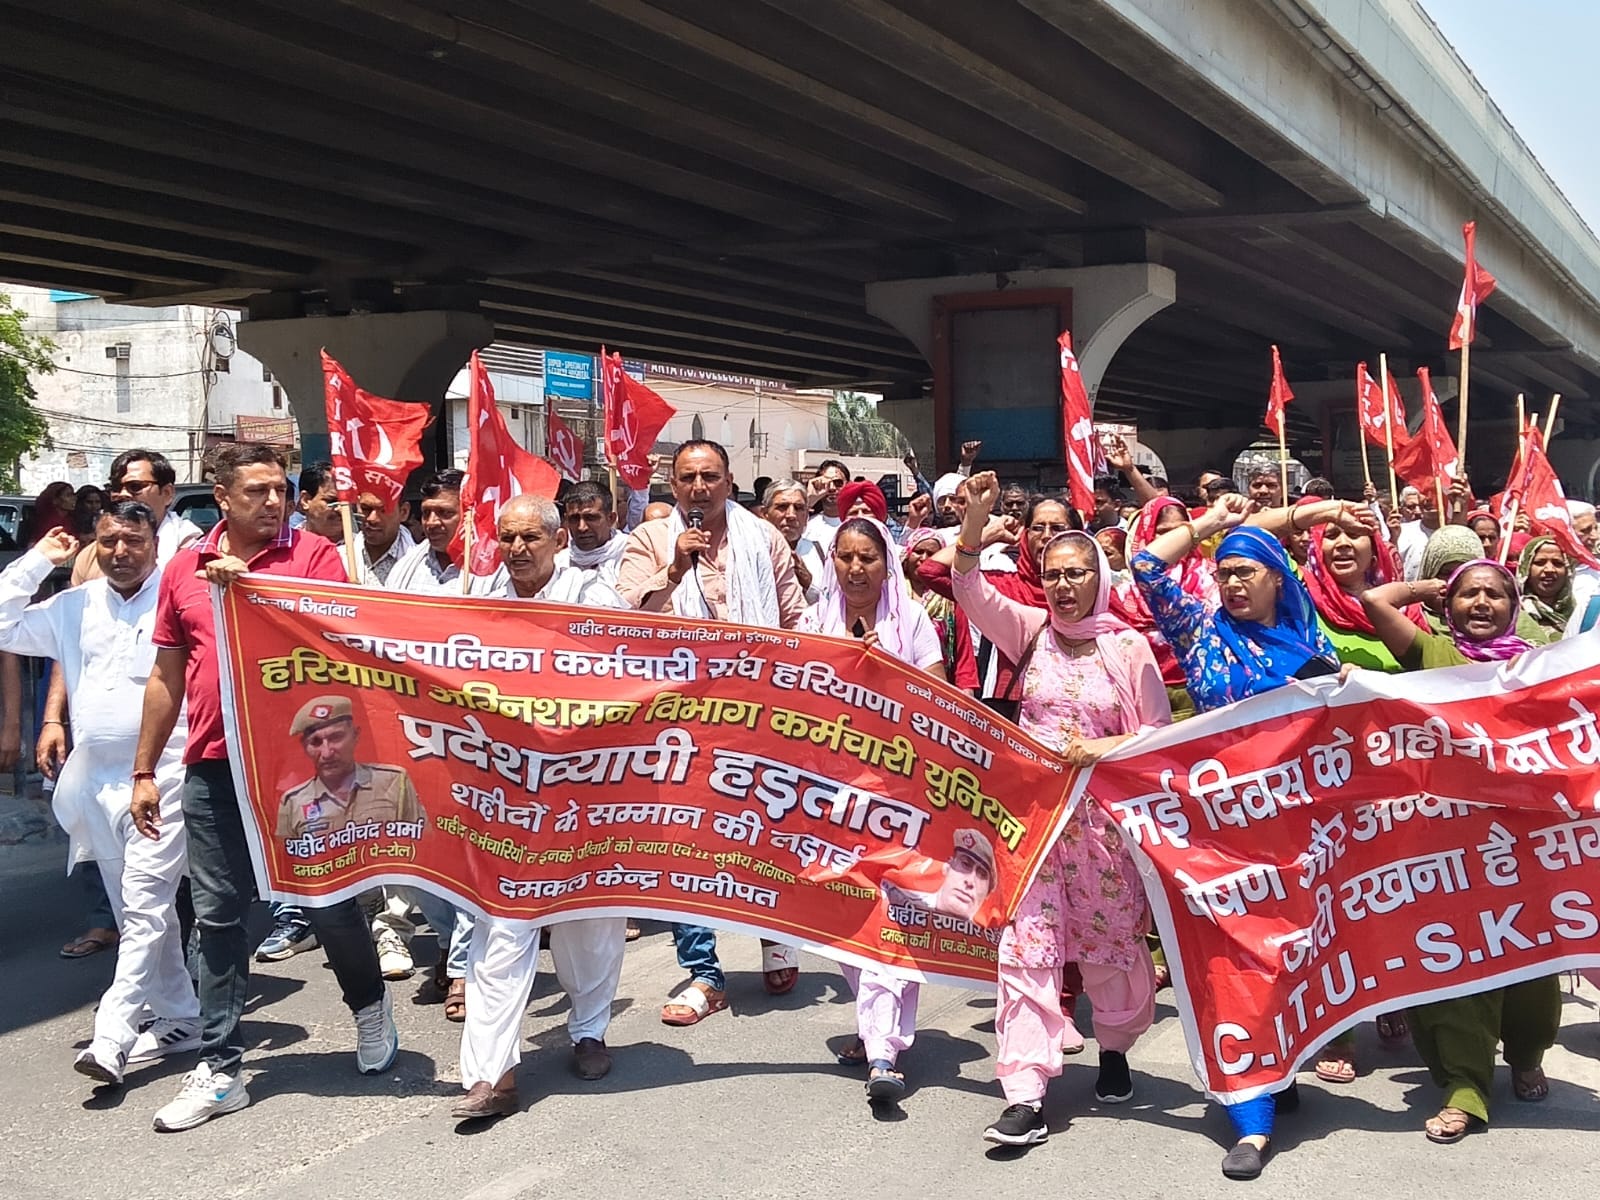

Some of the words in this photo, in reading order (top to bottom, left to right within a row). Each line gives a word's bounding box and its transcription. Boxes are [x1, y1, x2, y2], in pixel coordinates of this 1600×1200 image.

[569, 620, 603, 636] शहीद
[608, 625, 653, 639] दमकल
[656, 626, 723, 642] कर्मचारियों
[724, 632, 741, 642] को
[786, 637, 800, 649] दो
[554, 644, 699, 681] कर्मचारी
[708, 650, 766, 680] संघ
[772, 661, 904, 723] हरियाणा
[911, 711, 995, 770] शाखा
[257, 647, 417, 696] हरियाणा
[428, 681, 641, 726] अग्निशमन
[645, 691, 762, 728] विभाग
[770, 706, 917, 776] कर्मचारी
[924, 758, 1026, 850] युनियन
[398, 714, 698, 792] प्रदेशव्यापी
[709, 749, 930, 847] हड़ताल
[1110, 769, 1190, 848] मई
[1189, 759, 1314, 831] दिवस
[1307, 727, 1354, 788] के
[1497, 728, 1569, 774] का
[286, 833, 326, 857] शहीद
[386, 819, 424, 839] शर्मा
[436, 815, 468, 838] शहीद
[614, 838, 634, 853] को
[637, 842, 669, 855] न्याय
[451, 782, 550, 832] शहीदों
[555, 800, 580, 833] के
[587, 802, 706, 829] सम्मान
[713, 810, 764, 846] की
[292, 861, 333, 877] दमकल
[499, 870, 591, 899] दमकल
[596, 864, 662, 891] केन्द्र
[669, 871, 780, 908] पानीपत
[1340, 848, 1471, 921] रखना
[1476, 821, 1519, 887] है
[888, 902, 929, 926] शहीद
